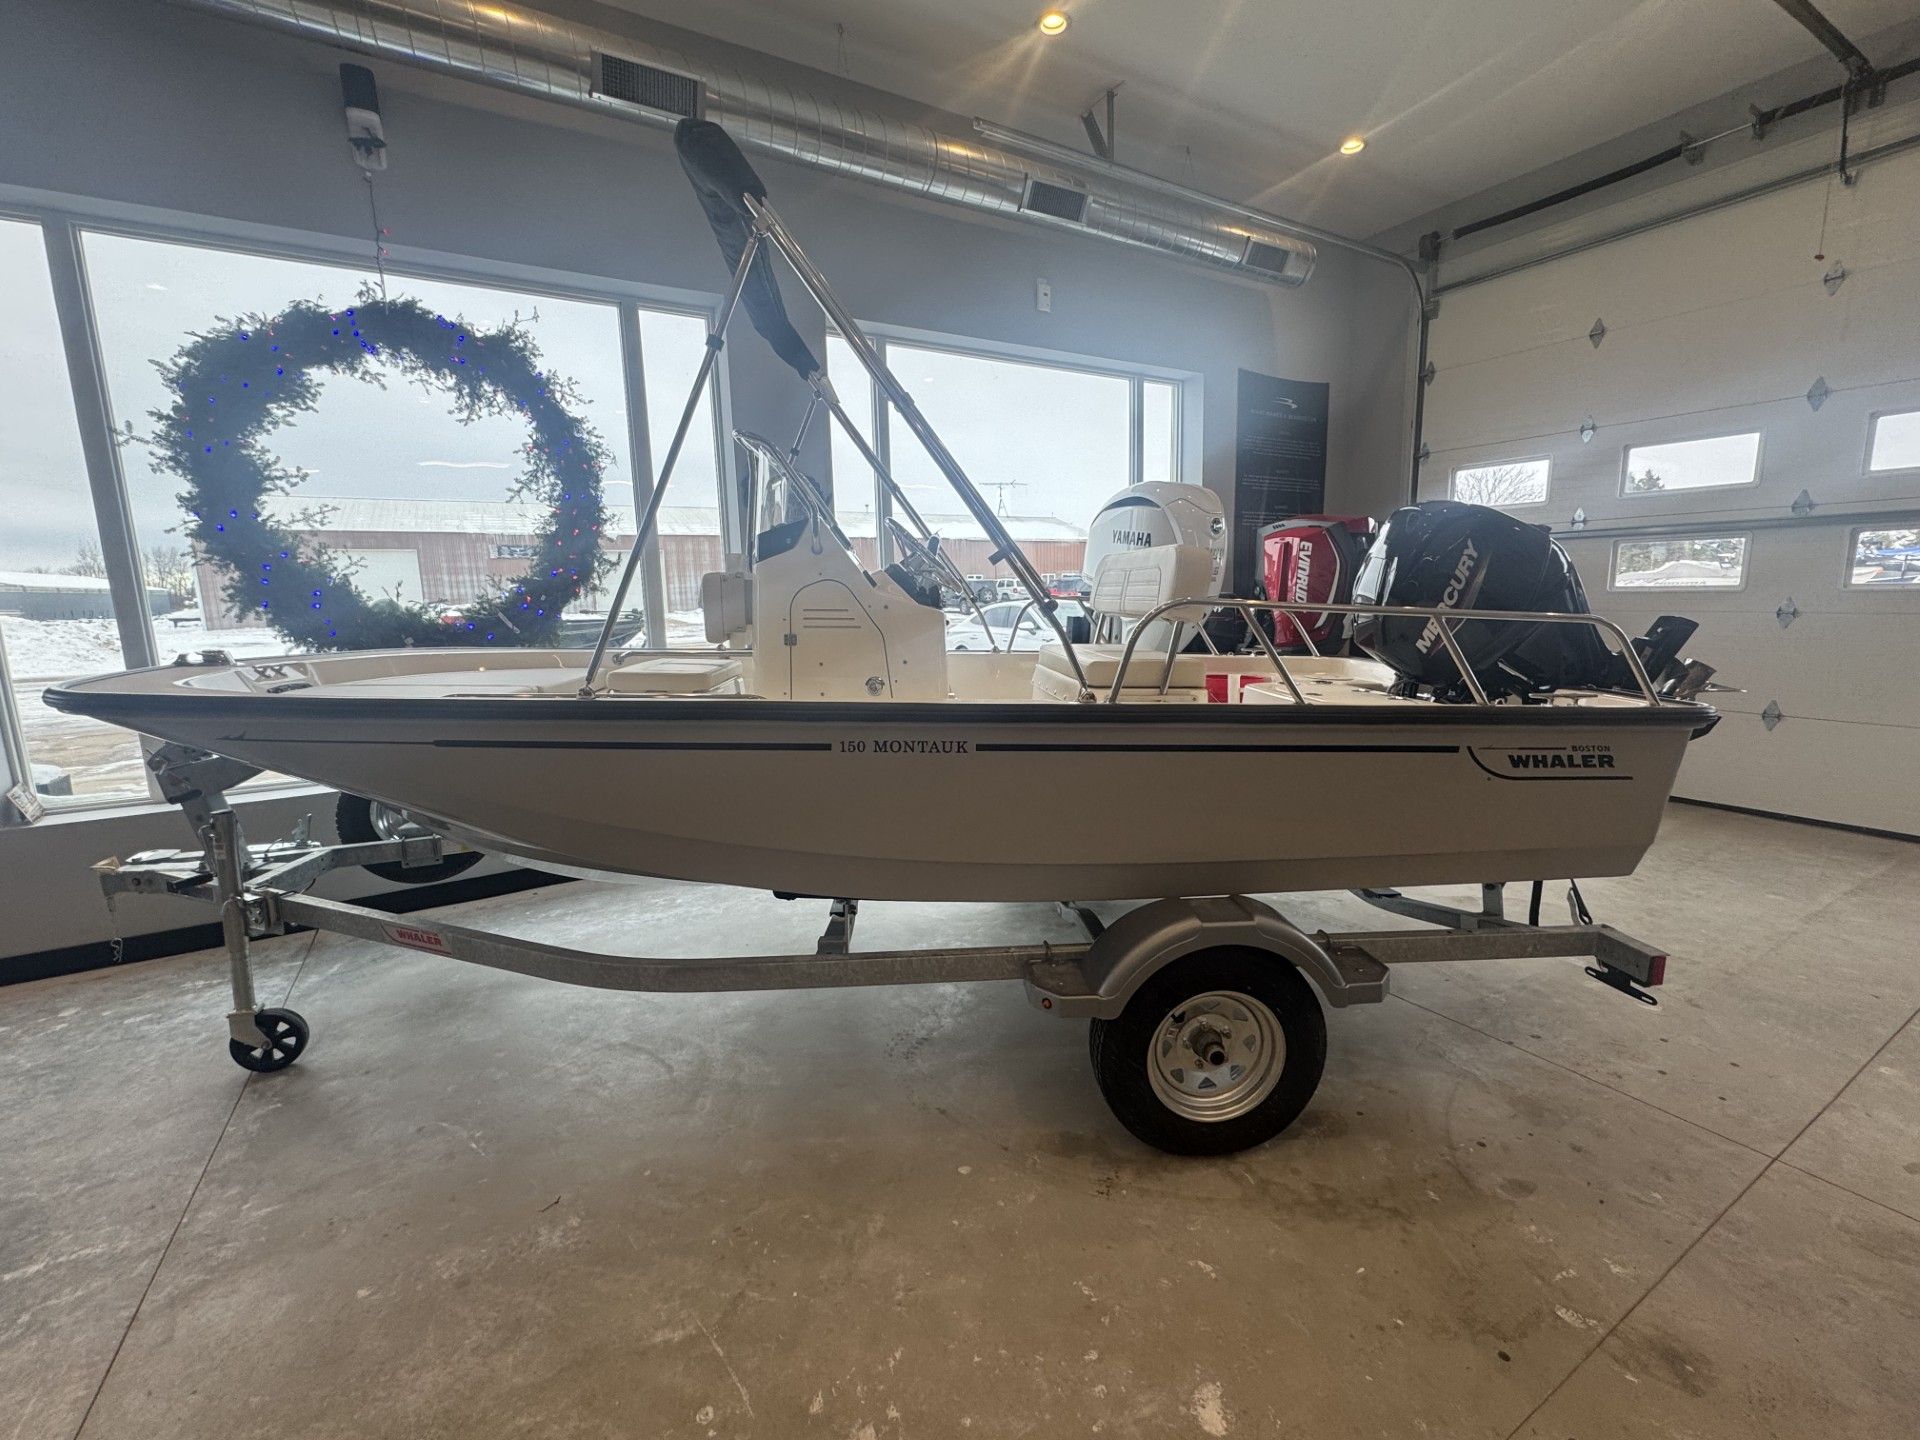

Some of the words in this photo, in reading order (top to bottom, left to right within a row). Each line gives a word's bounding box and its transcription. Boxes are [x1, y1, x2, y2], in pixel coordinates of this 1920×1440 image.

[1112, 529, 1152, 547] YAMAHA
[1295, 541, 1313, 605] EVINRUD
[839, 741, 866, 753] 150
[873, 740, 968, 753] MONTAUK
[1571, 744, 1611, 753] BOSTON
[1507, 754, 1616, 769] WHALER
[396, 929, 442, 946] WHALER
